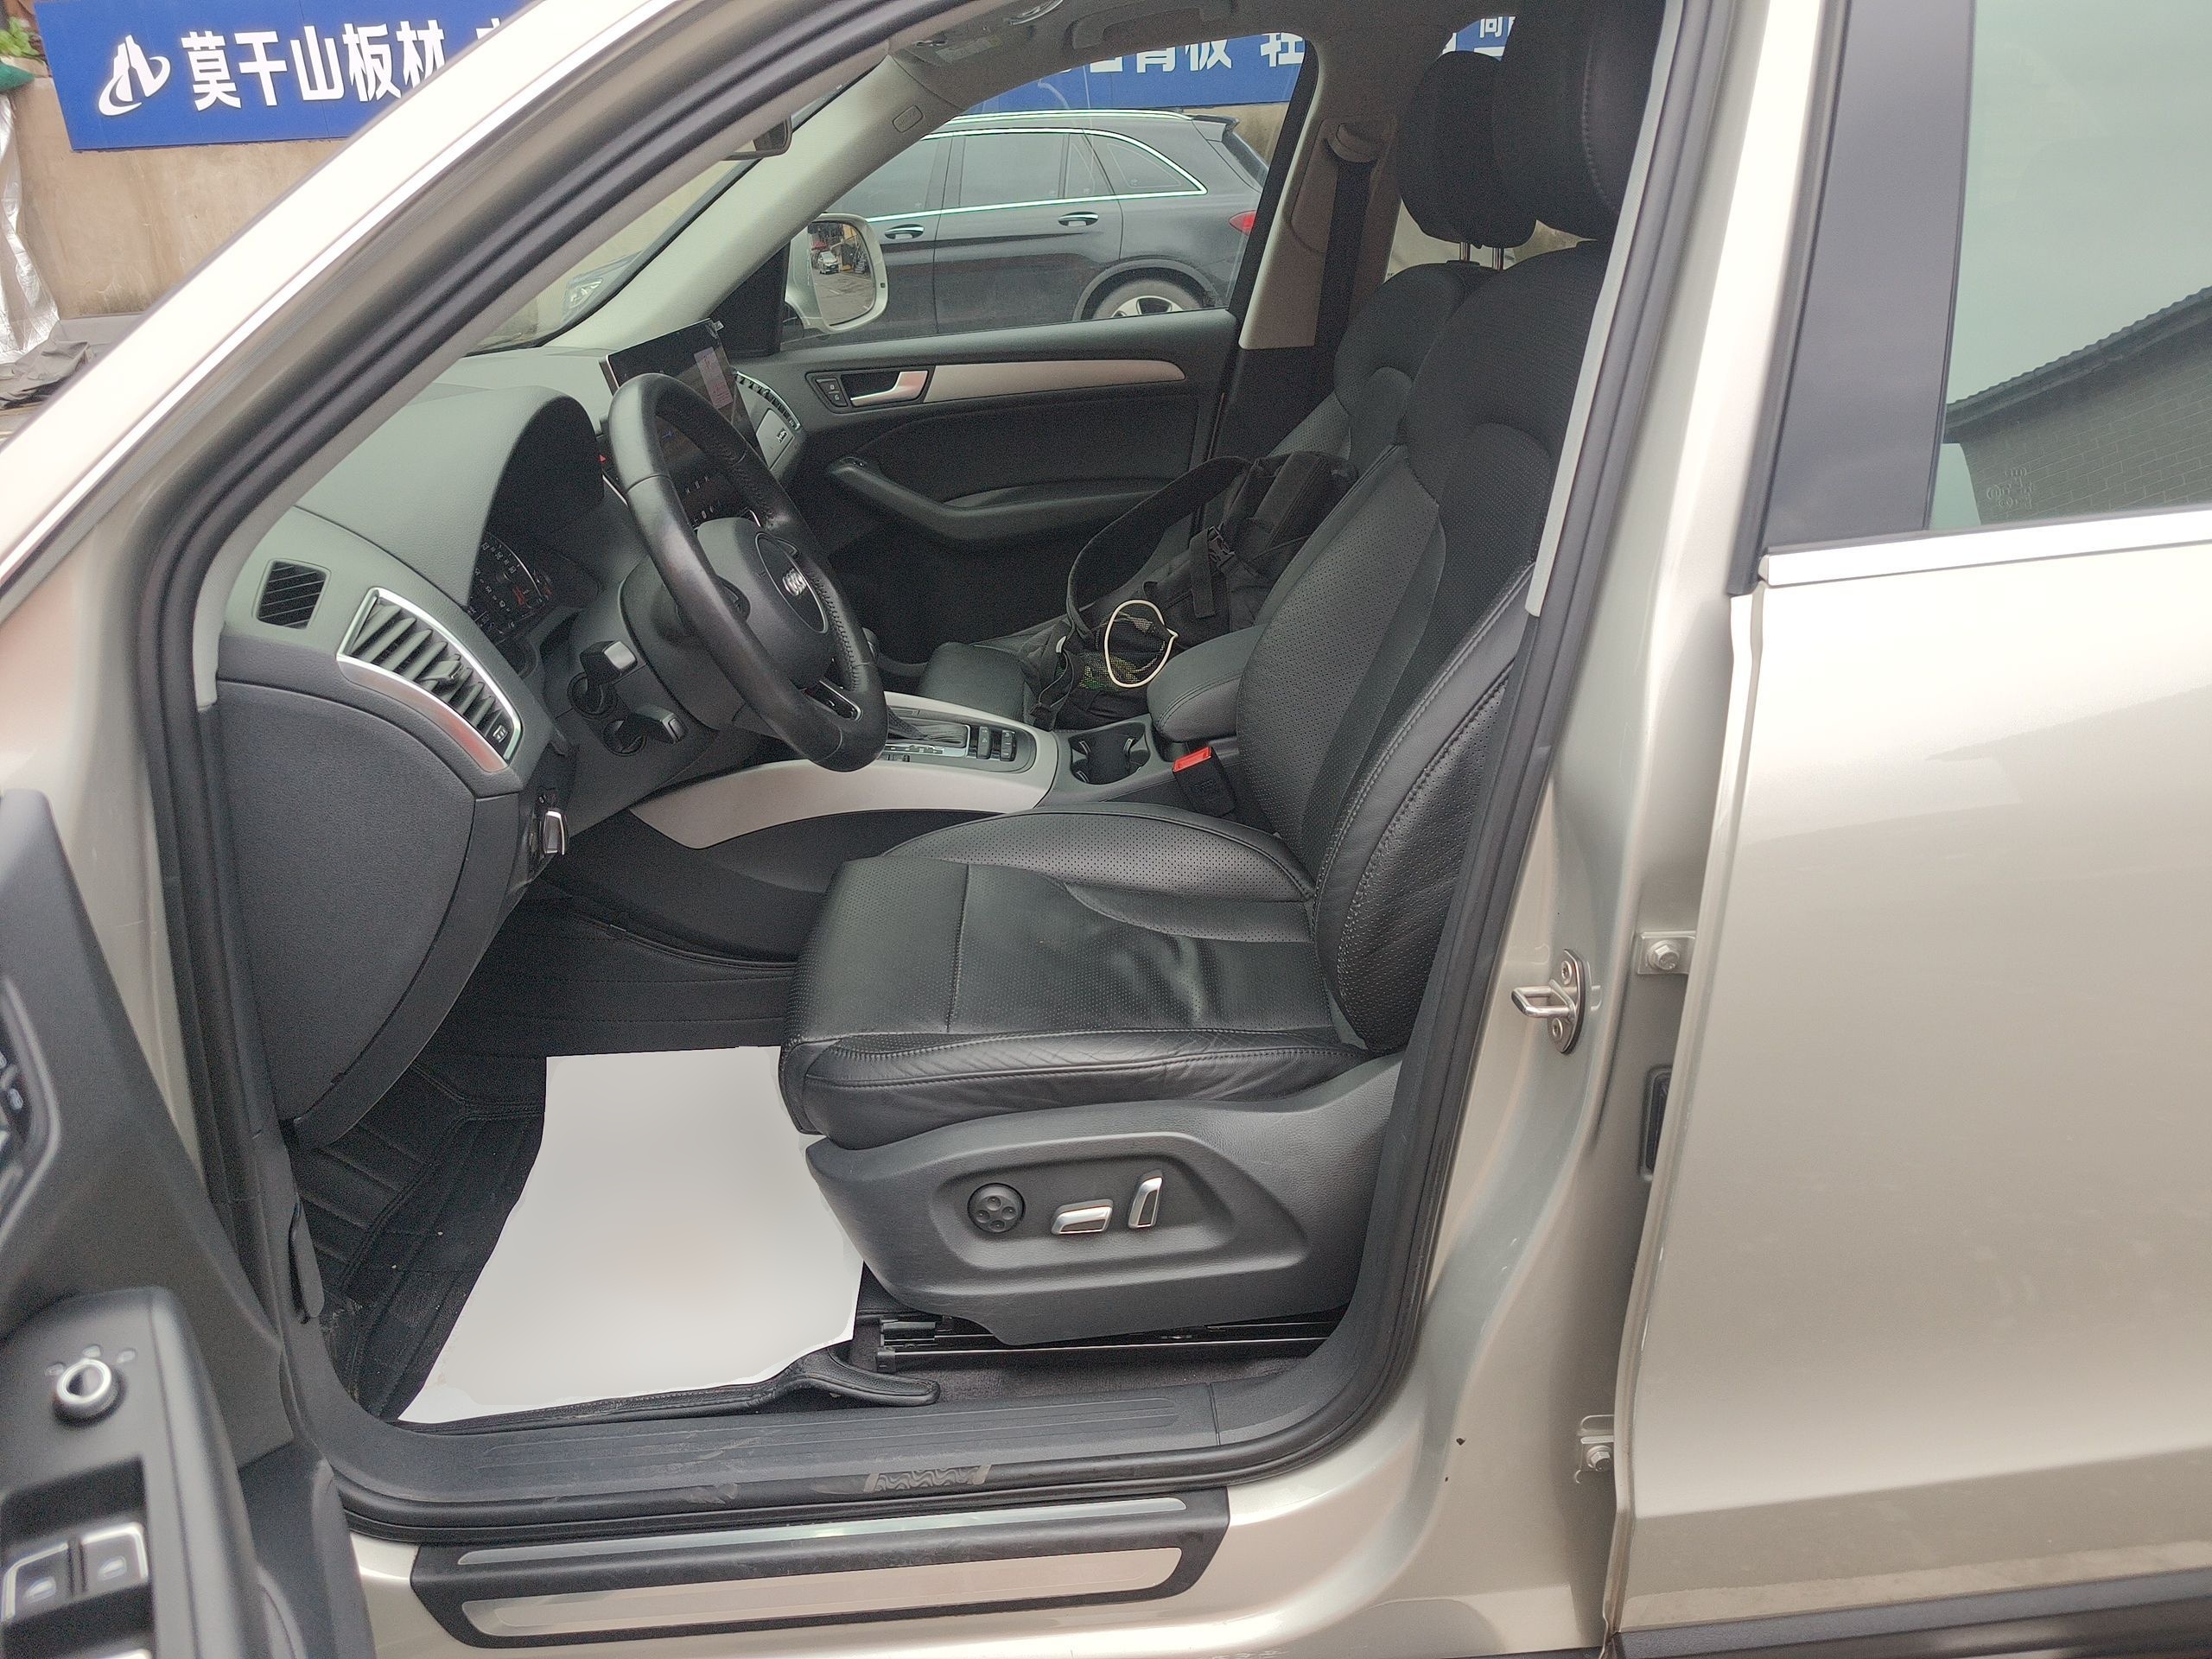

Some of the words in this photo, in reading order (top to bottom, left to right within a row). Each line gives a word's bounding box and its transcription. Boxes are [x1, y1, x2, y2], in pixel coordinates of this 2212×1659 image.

[181, 19, 445, 111] 莫干山板材
